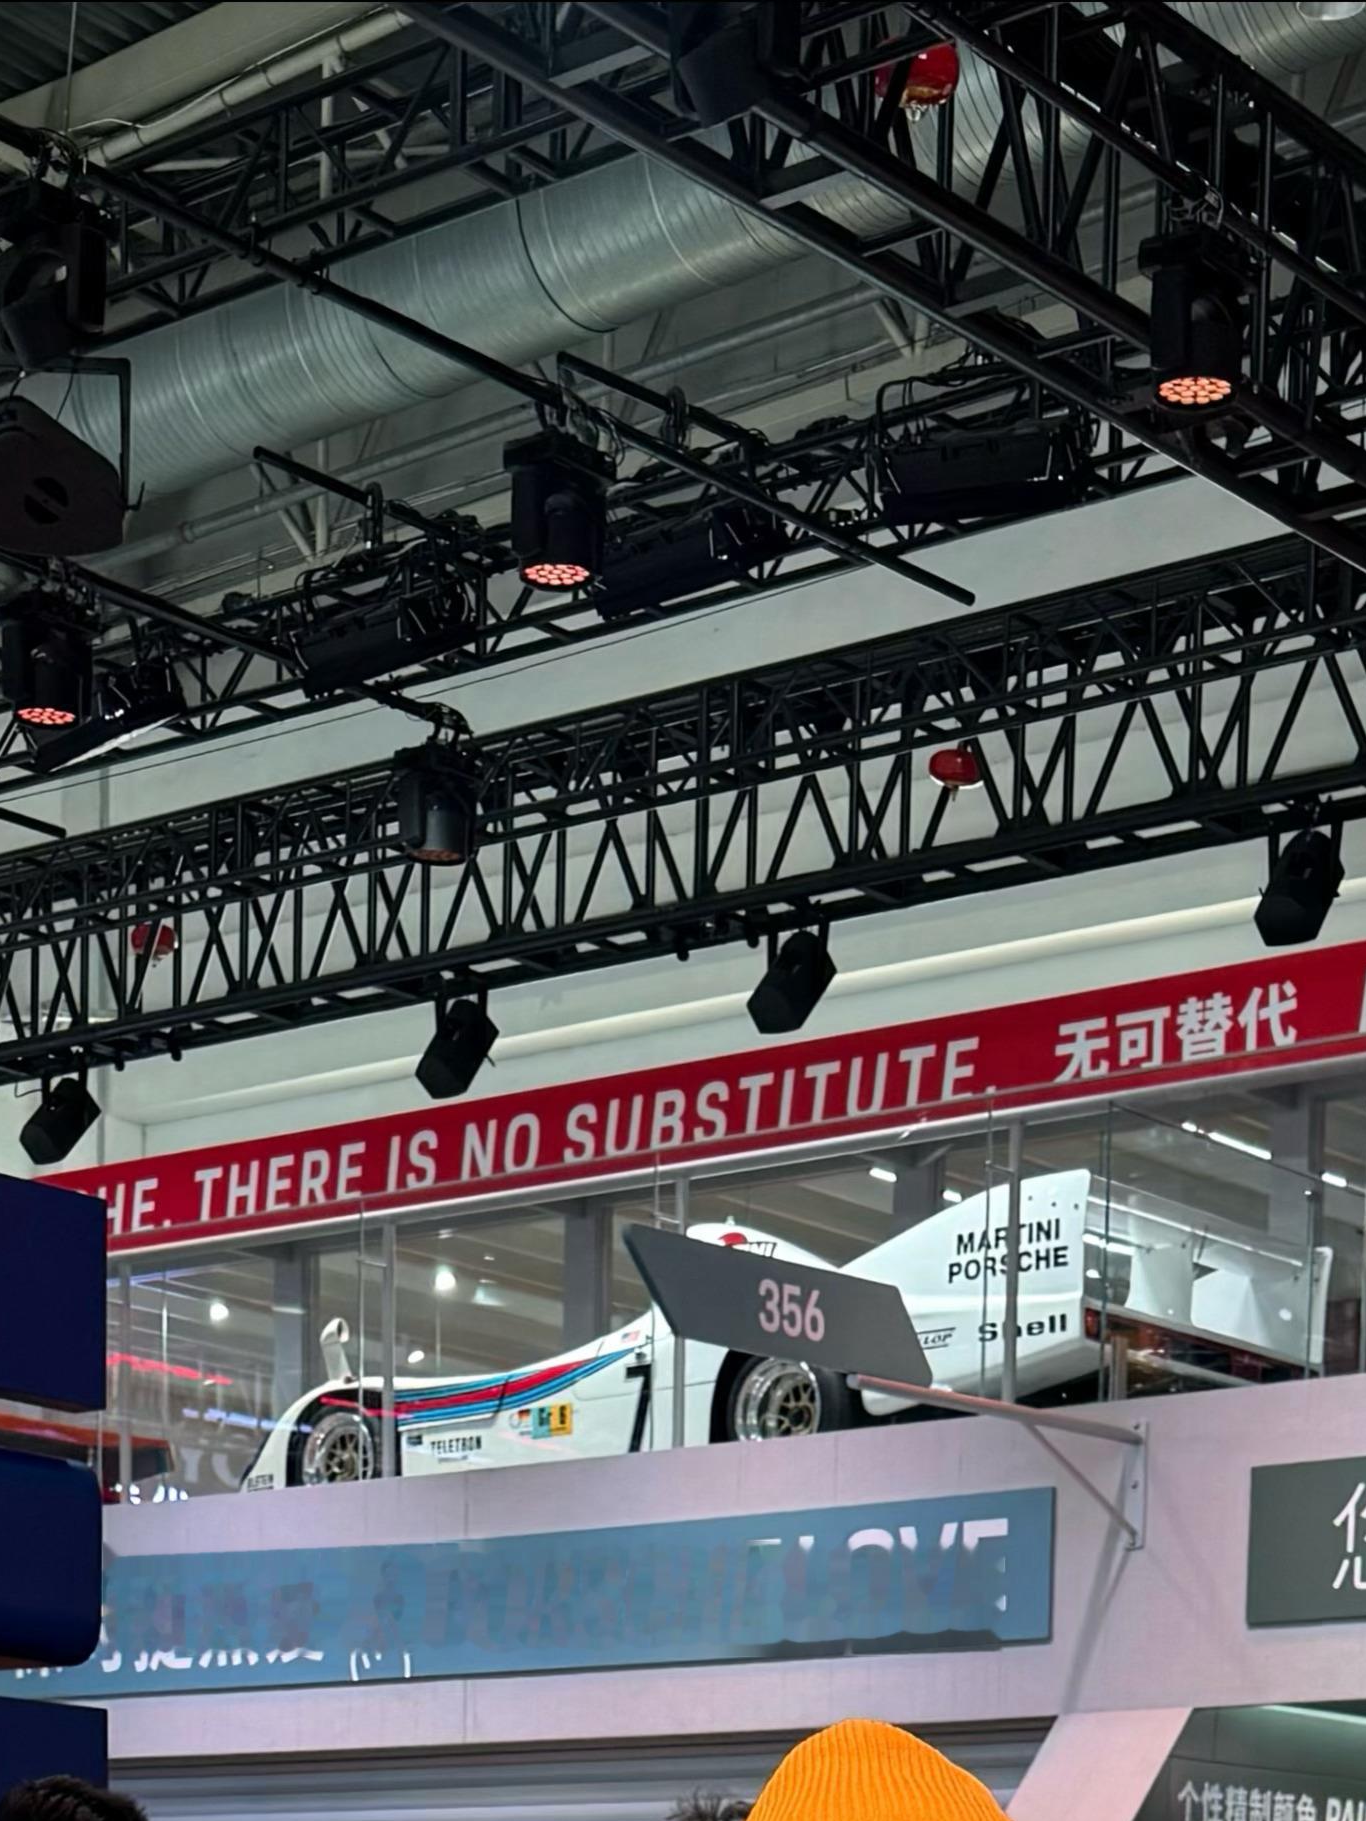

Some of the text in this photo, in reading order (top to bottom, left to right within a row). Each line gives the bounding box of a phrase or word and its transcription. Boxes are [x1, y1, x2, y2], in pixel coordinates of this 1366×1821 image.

[194, 1140, 366, 1222] THERE
[386, 1129, 439, 1192] IS
[461, 1113, 541, 1182] NO
[562, 1036, 998, 1165] SUBSTITUTE.
[1054, 982, 1298, 1084] 无可替代
[758, 1278, 826, 1342] 356
